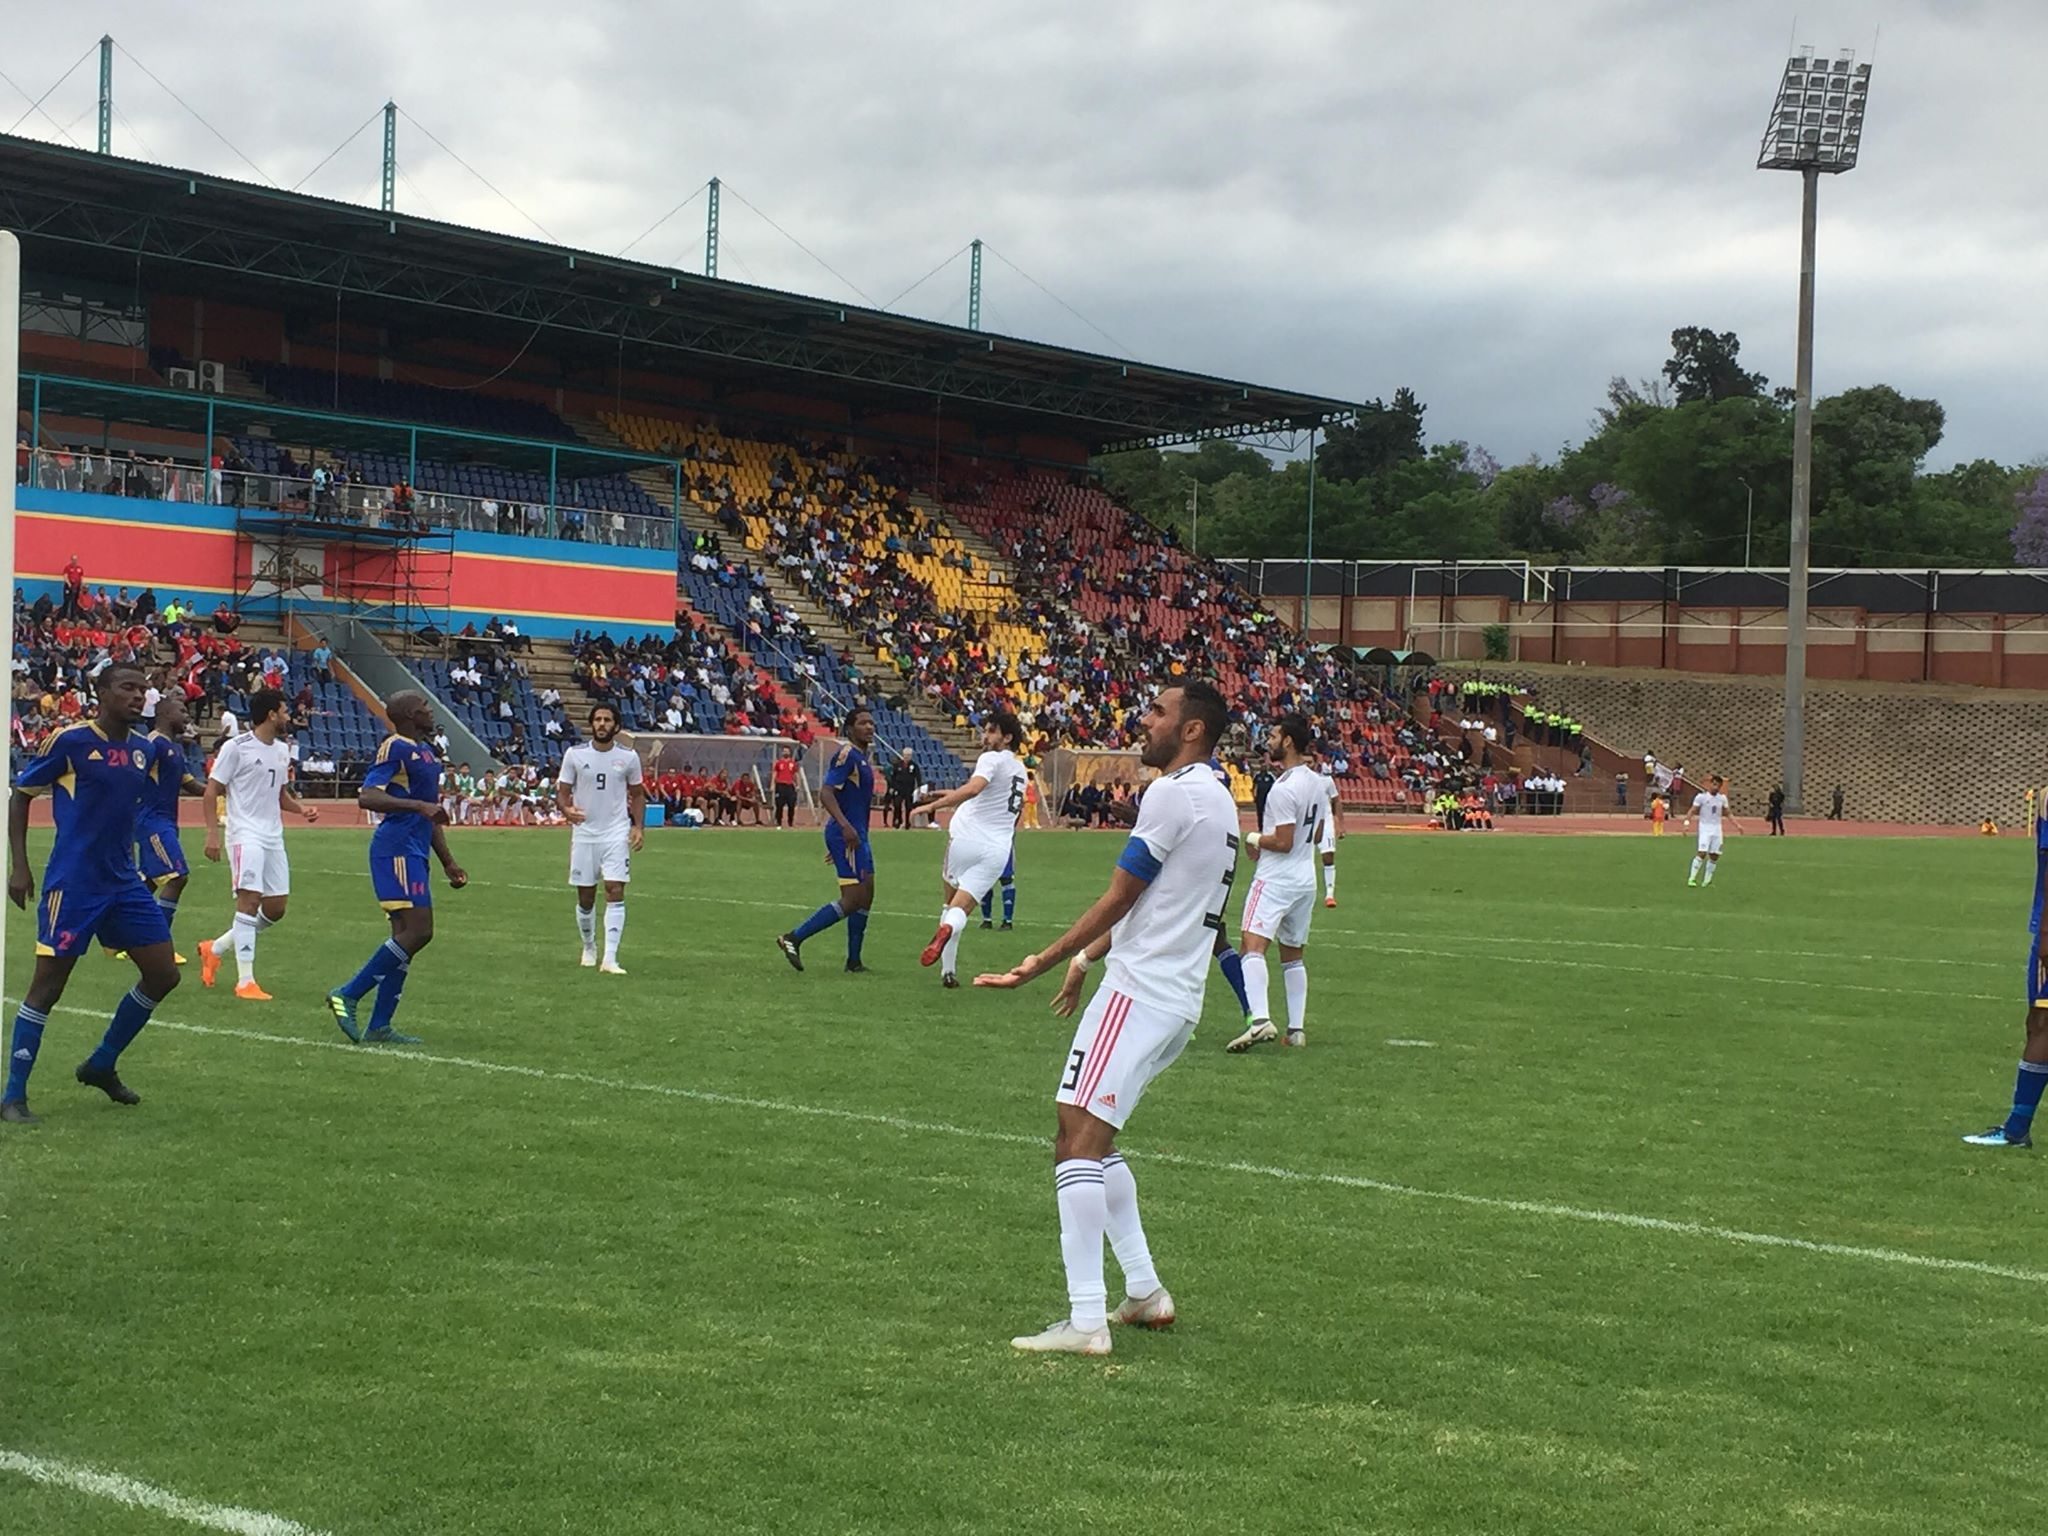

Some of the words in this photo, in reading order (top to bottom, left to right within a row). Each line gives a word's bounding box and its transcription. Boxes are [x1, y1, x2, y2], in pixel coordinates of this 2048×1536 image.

[268, 768, 276, 788] 7
[596, 773, 606, 790] 9
[1008, 775, 1025, 815] 6
[1303, 803, 1318, 844] 4
[1062, 1048, 1086, 1091] 3
